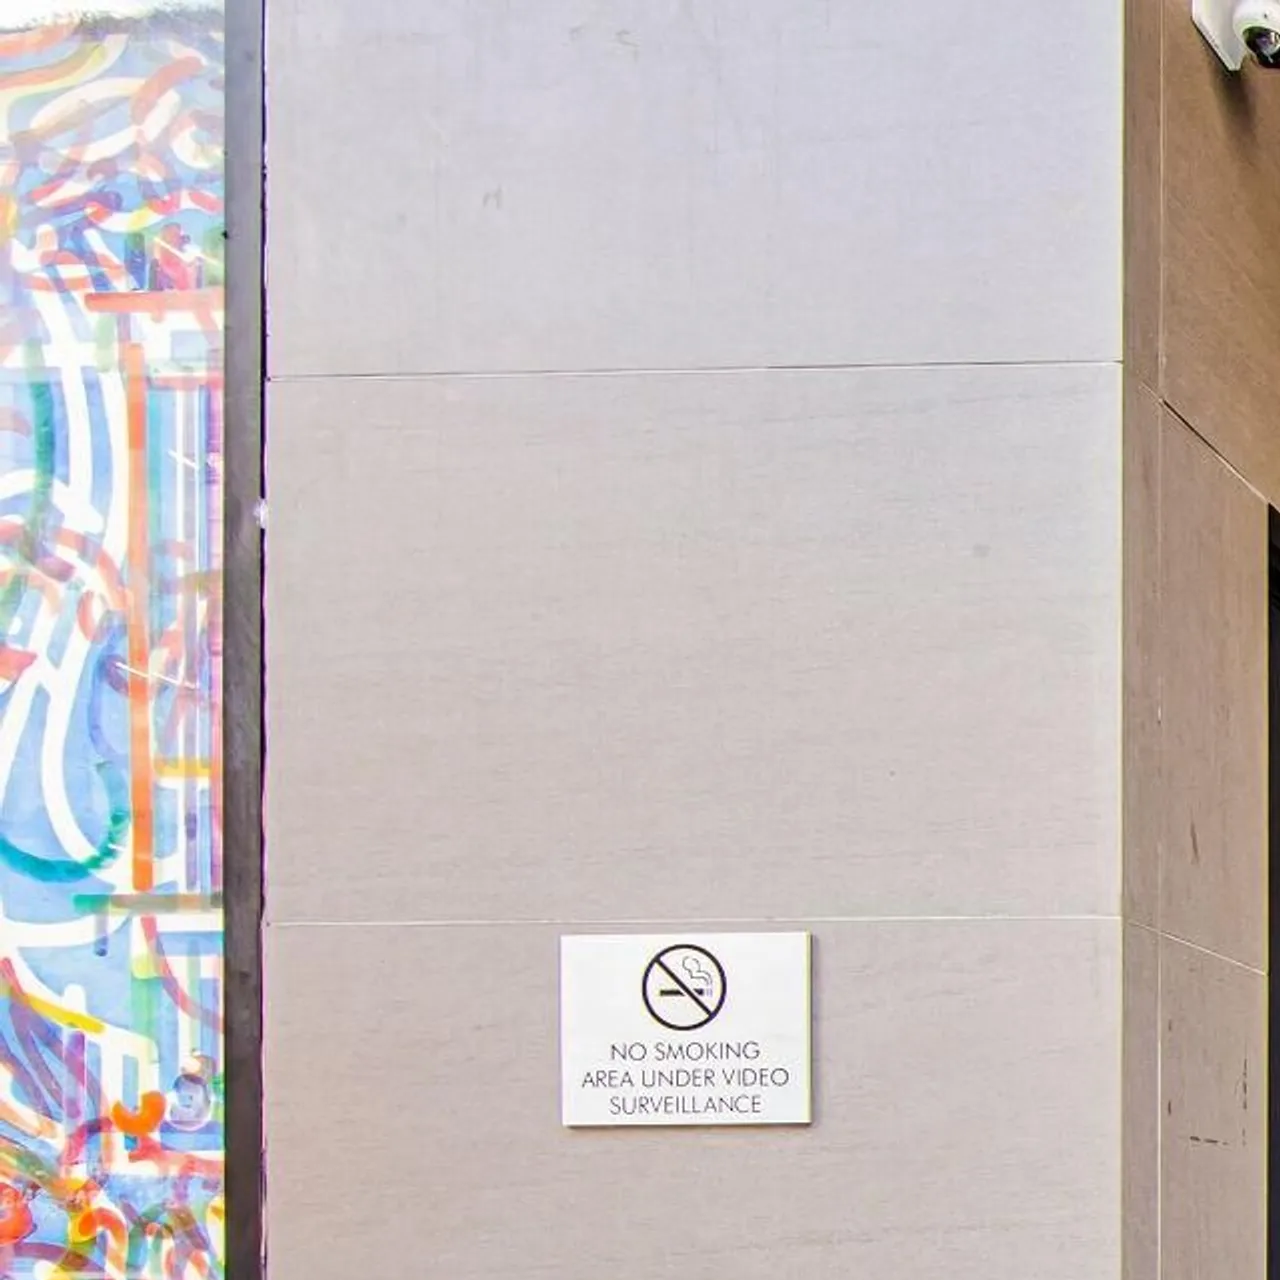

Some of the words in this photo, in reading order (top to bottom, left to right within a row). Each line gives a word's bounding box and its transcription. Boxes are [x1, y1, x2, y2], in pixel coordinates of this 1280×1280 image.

[609, 1041, 648, 1061] NO
[653, 1041, 761, 1061] SMOKING
[581, 1069, 635, 1088] AREA
[641, 1068, 716, 1087] UNDER
[721, 1067, 790, 1087] VIDEO
[609, 1094, 762, 1115] SURVEILLANCE
